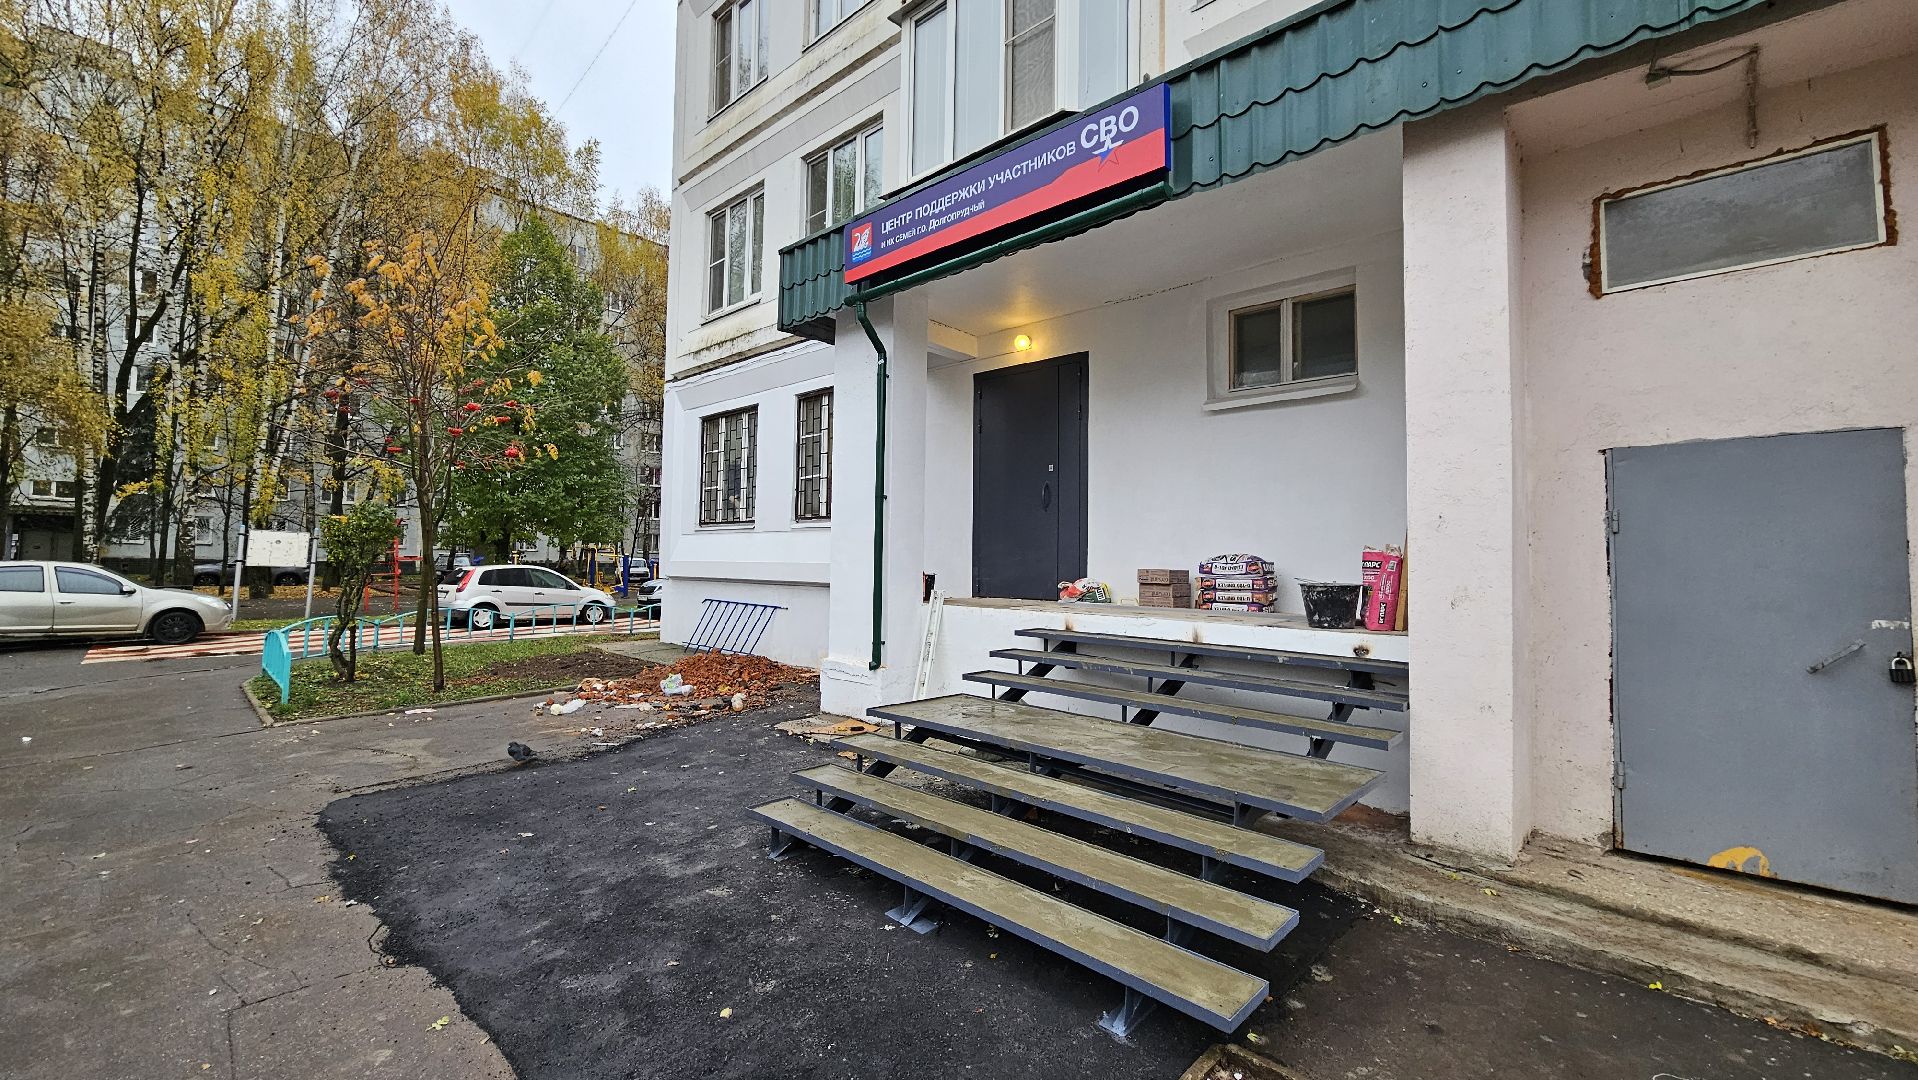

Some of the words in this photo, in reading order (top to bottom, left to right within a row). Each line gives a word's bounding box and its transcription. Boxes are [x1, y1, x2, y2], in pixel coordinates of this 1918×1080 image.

[881, 211, 912, 234] ЦЕНТР
[914, 179, 986, 220] ПОДДЕРЖКИ
[988, 141, 1076, 189] УЧАСТНИКОВ
[1080, 105, 1139, 149] СВО
[929, 199, 985, 231] Долгопрудный
